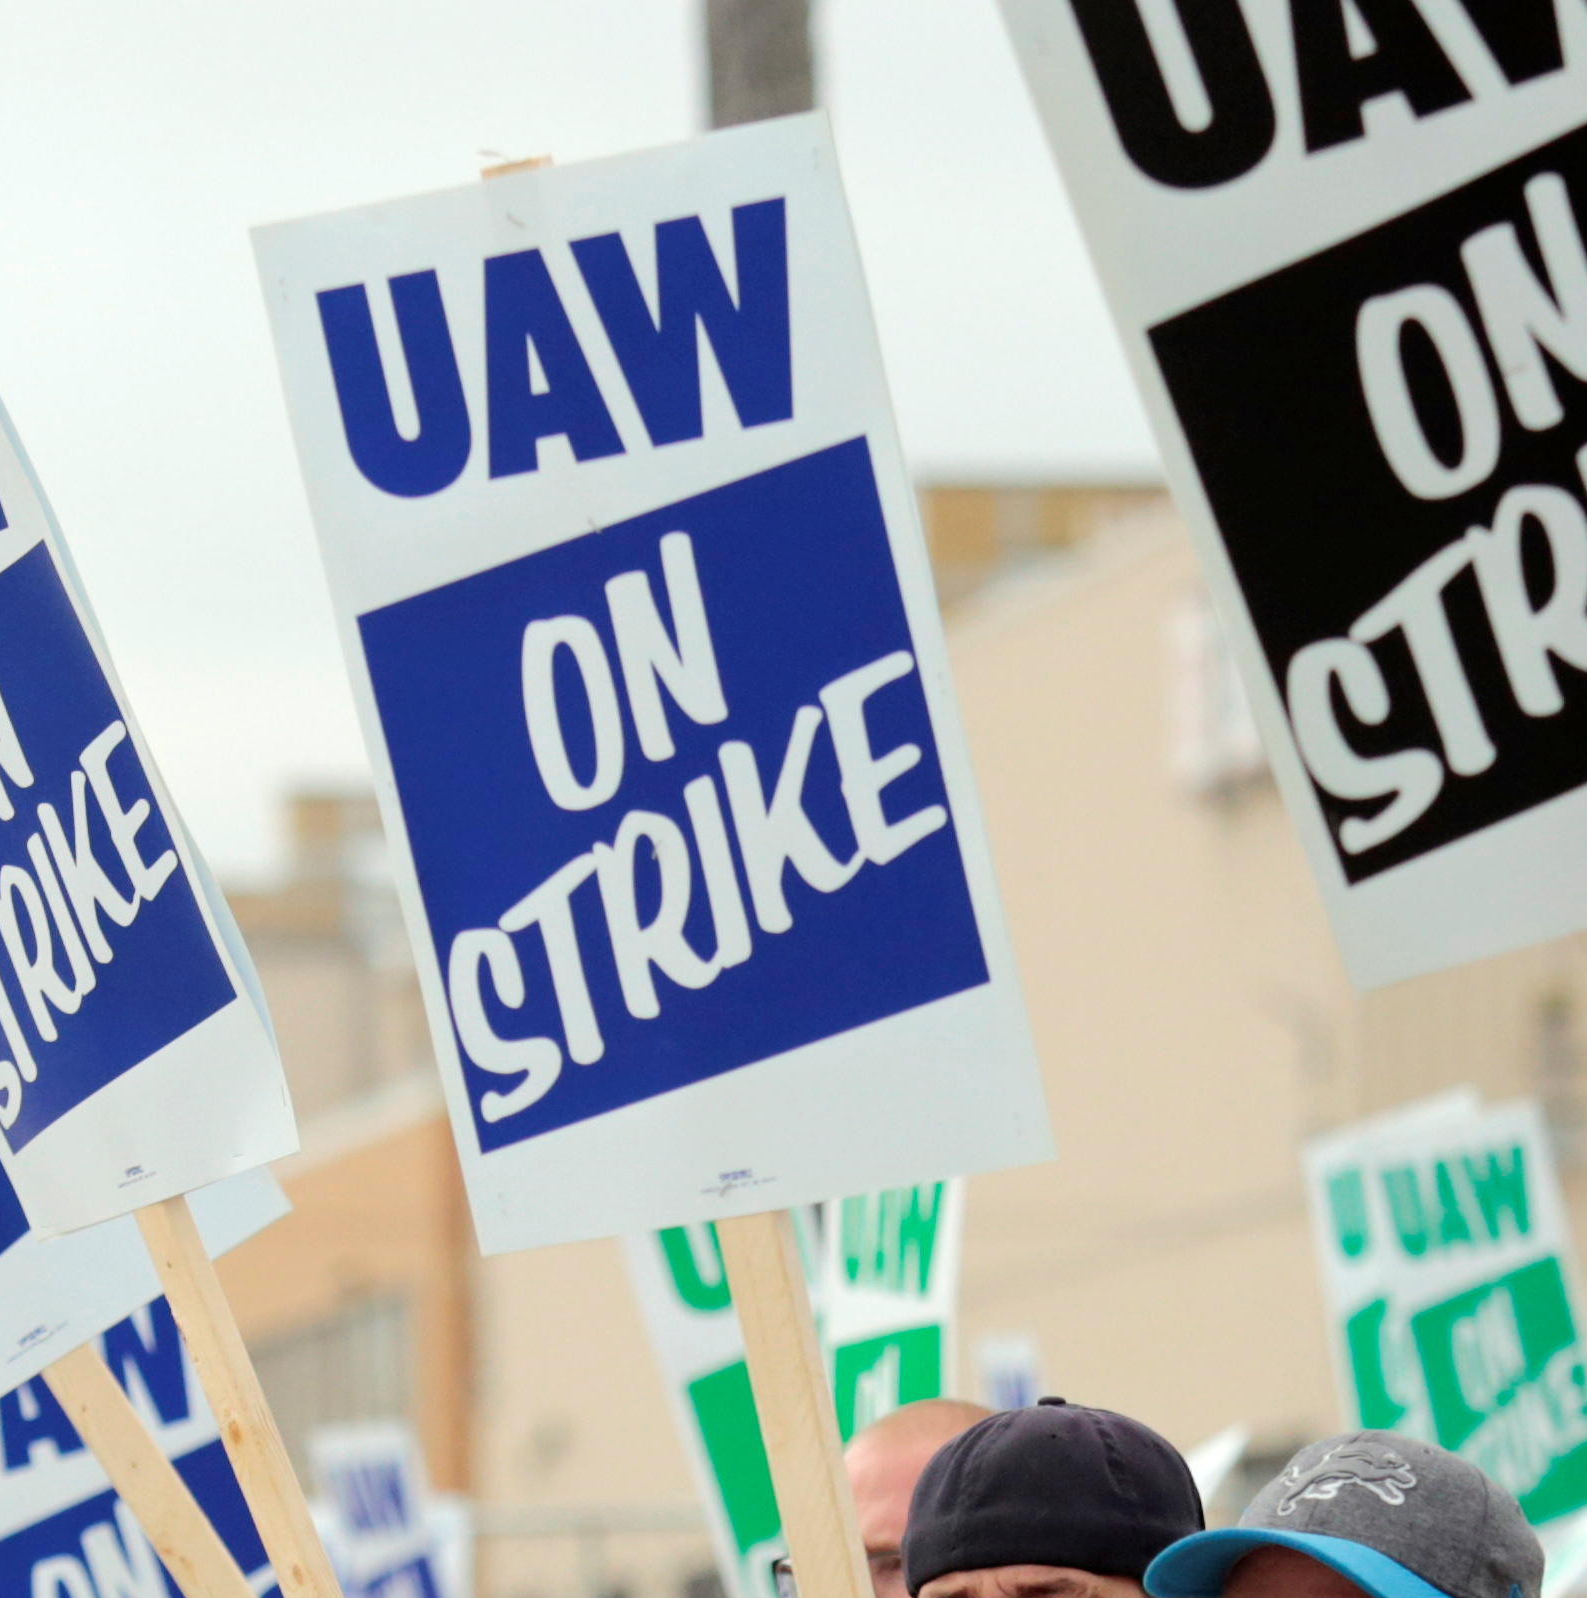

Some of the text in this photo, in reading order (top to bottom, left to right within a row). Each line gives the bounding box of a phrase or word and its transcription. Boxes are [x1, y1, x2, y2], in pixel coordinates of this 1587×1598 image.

[315, 195, 794, 498] UAW
[521, 530, 728, 811] ON
[447, 650, 947, 1123] STRIKE
[1381, 1145, 1531, 1257] UAW
